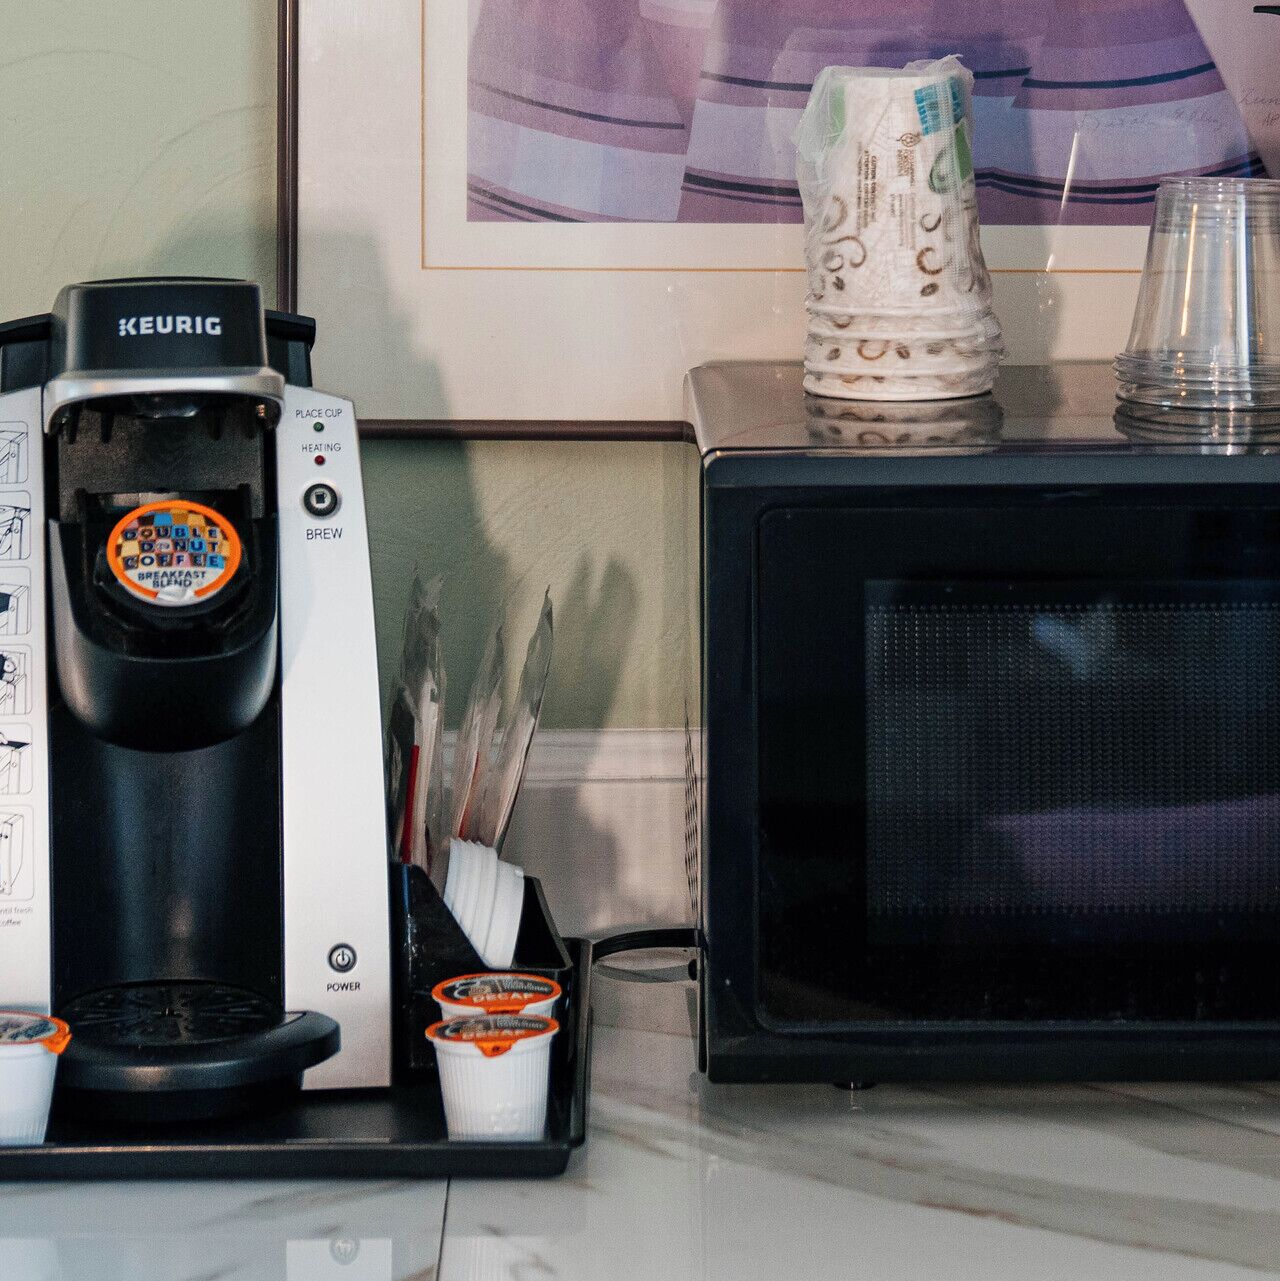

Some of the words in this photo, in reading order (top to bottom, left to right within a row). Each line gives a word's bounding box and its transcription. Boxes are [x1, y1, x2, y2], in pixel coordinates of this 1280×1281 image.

[119, 316, 222, 336] KEURIG
[295, 409, 323, 419] PLACE
[325, 408, 343, 418] CUP
[301, 442, 342, 453] HEATING
[123, 526, 219, 540] DOUBLE
[306, 528, 343, 541] BREW
[141, 540, 220, 552] DONUT
[124, 554, 220, 569] COFFEE
[137, 570, 206, 582] BREAKFAST
[152, 578, 193, 588] BLEND
[326, 982, 361, 992] POWER
[473, 991, 535, 1003] DECAF
